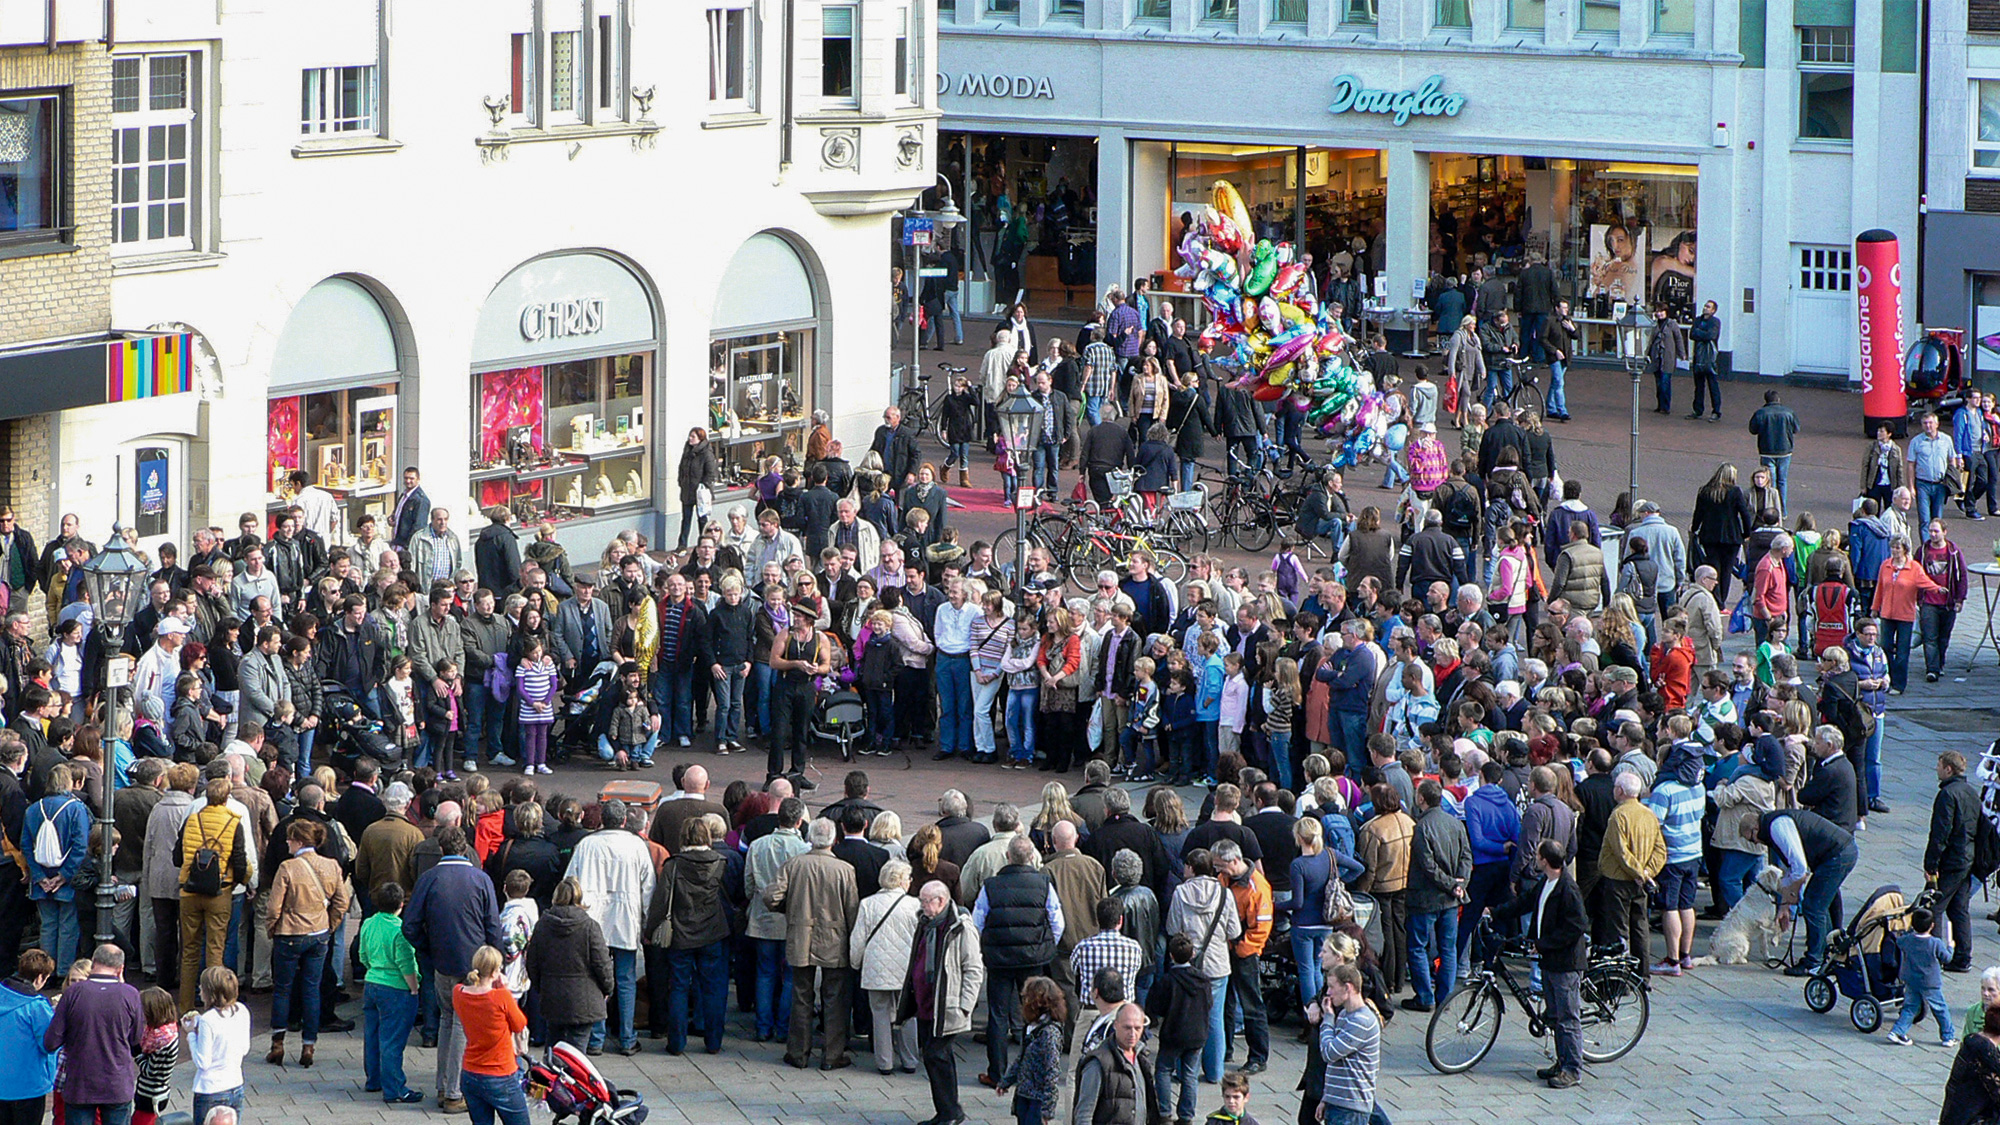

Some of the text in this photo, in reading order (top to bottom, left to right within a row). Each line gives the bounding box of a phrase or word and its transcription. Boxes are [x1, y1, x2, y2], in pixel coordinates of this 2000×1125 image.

[957, 73, 1055, 100] MODA
[1328, 74, 1464, 126] Douglas
[1668, 276, 1690, 288] Dior
[519, 298, 607, 342] CHRIST
[85, 474, 93, 486] 2
